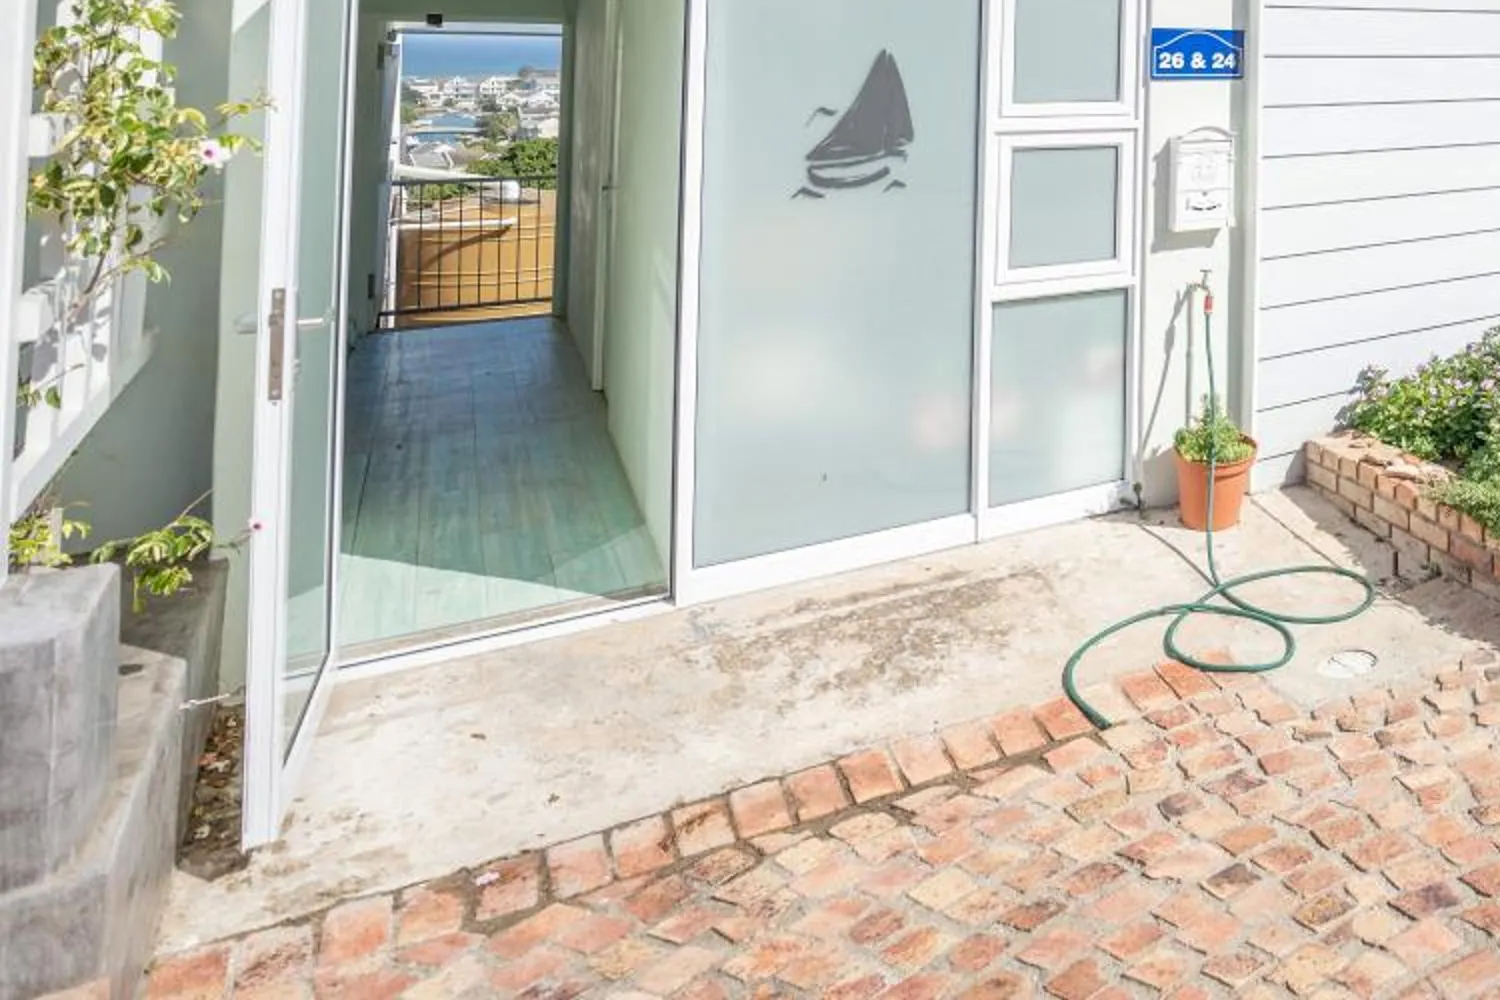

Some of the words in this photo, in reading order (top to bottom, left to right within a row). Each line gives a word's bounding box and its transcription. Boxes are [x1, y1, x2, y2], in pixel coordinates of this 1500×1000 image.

[1159, 52, 1185, 69] 26
[1190, 52, 1206, 69] &
[1211, 52, 1236, 69] 24
